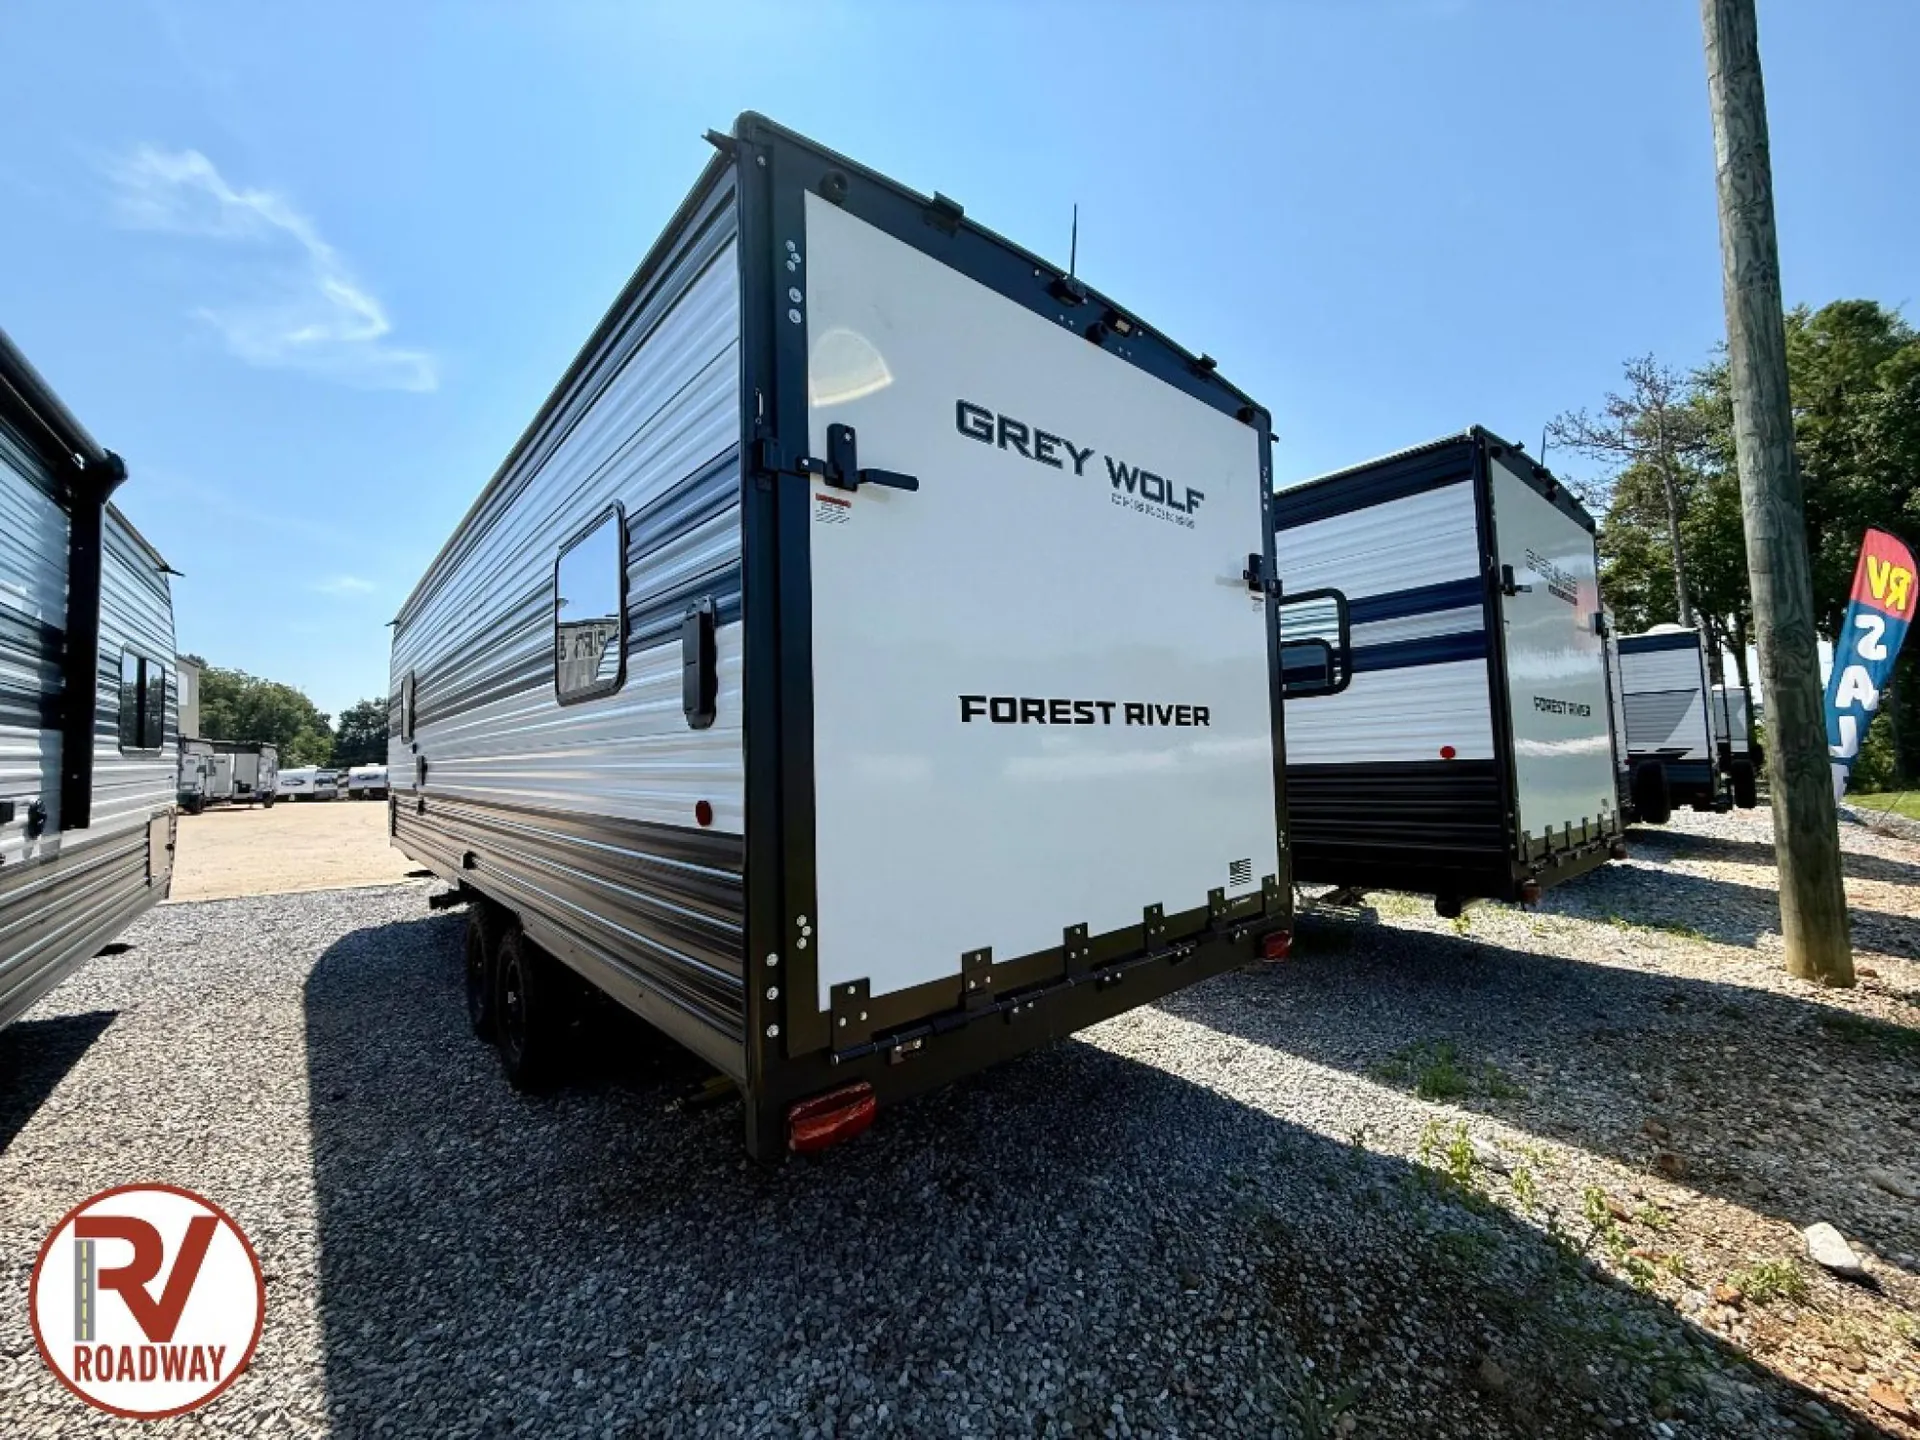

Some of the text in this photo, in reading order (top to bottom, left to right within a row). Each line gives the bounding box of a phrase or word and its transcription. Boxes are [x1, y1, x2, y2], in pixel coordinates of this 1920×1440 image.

[956, 399, 1204, 514] GREY WOLF
[958, 695, 1210, 727] FOREST RIVER
